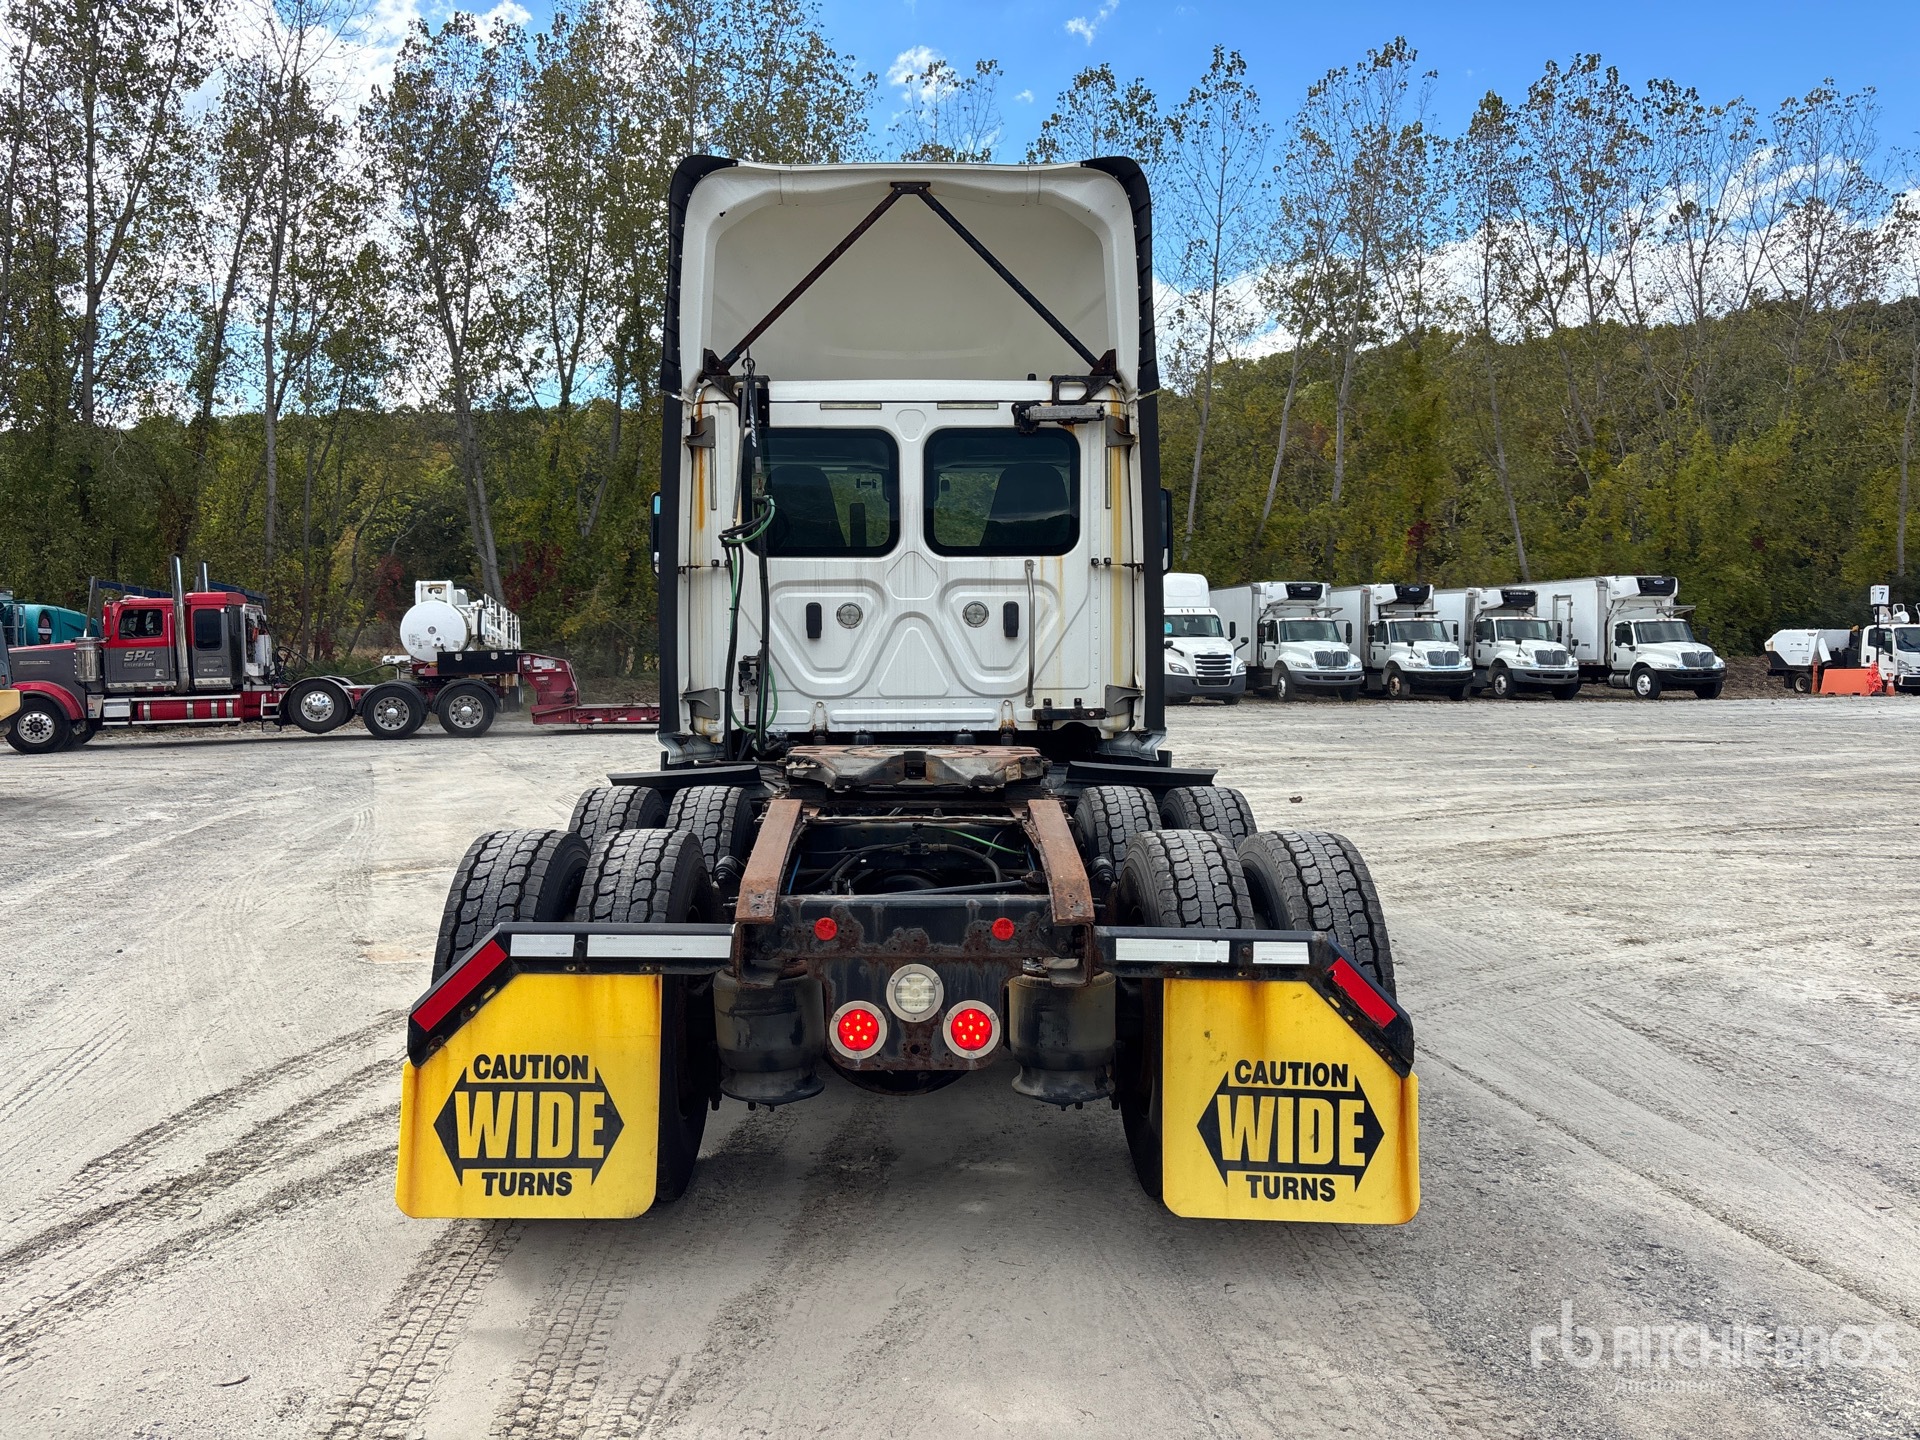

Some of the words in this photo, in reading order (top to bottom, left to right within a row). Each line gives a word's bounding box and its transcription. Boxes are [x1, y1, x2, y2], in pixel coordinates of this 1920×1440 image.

[1879, 591, 1885, 600] 7
[124, 650, 155, 661] SPC
[473, 1054, 589, 1080] CAUTION
[1234, 1060, 1348, 1087] CAUTION
[454, 1091, 605, 1159] WIDE
[1216, 1094, 1366, 1167] WIDE
[481, 1172, 573, 1196] TURNS
[1246, 1175, 1336, 1202] TURNS
